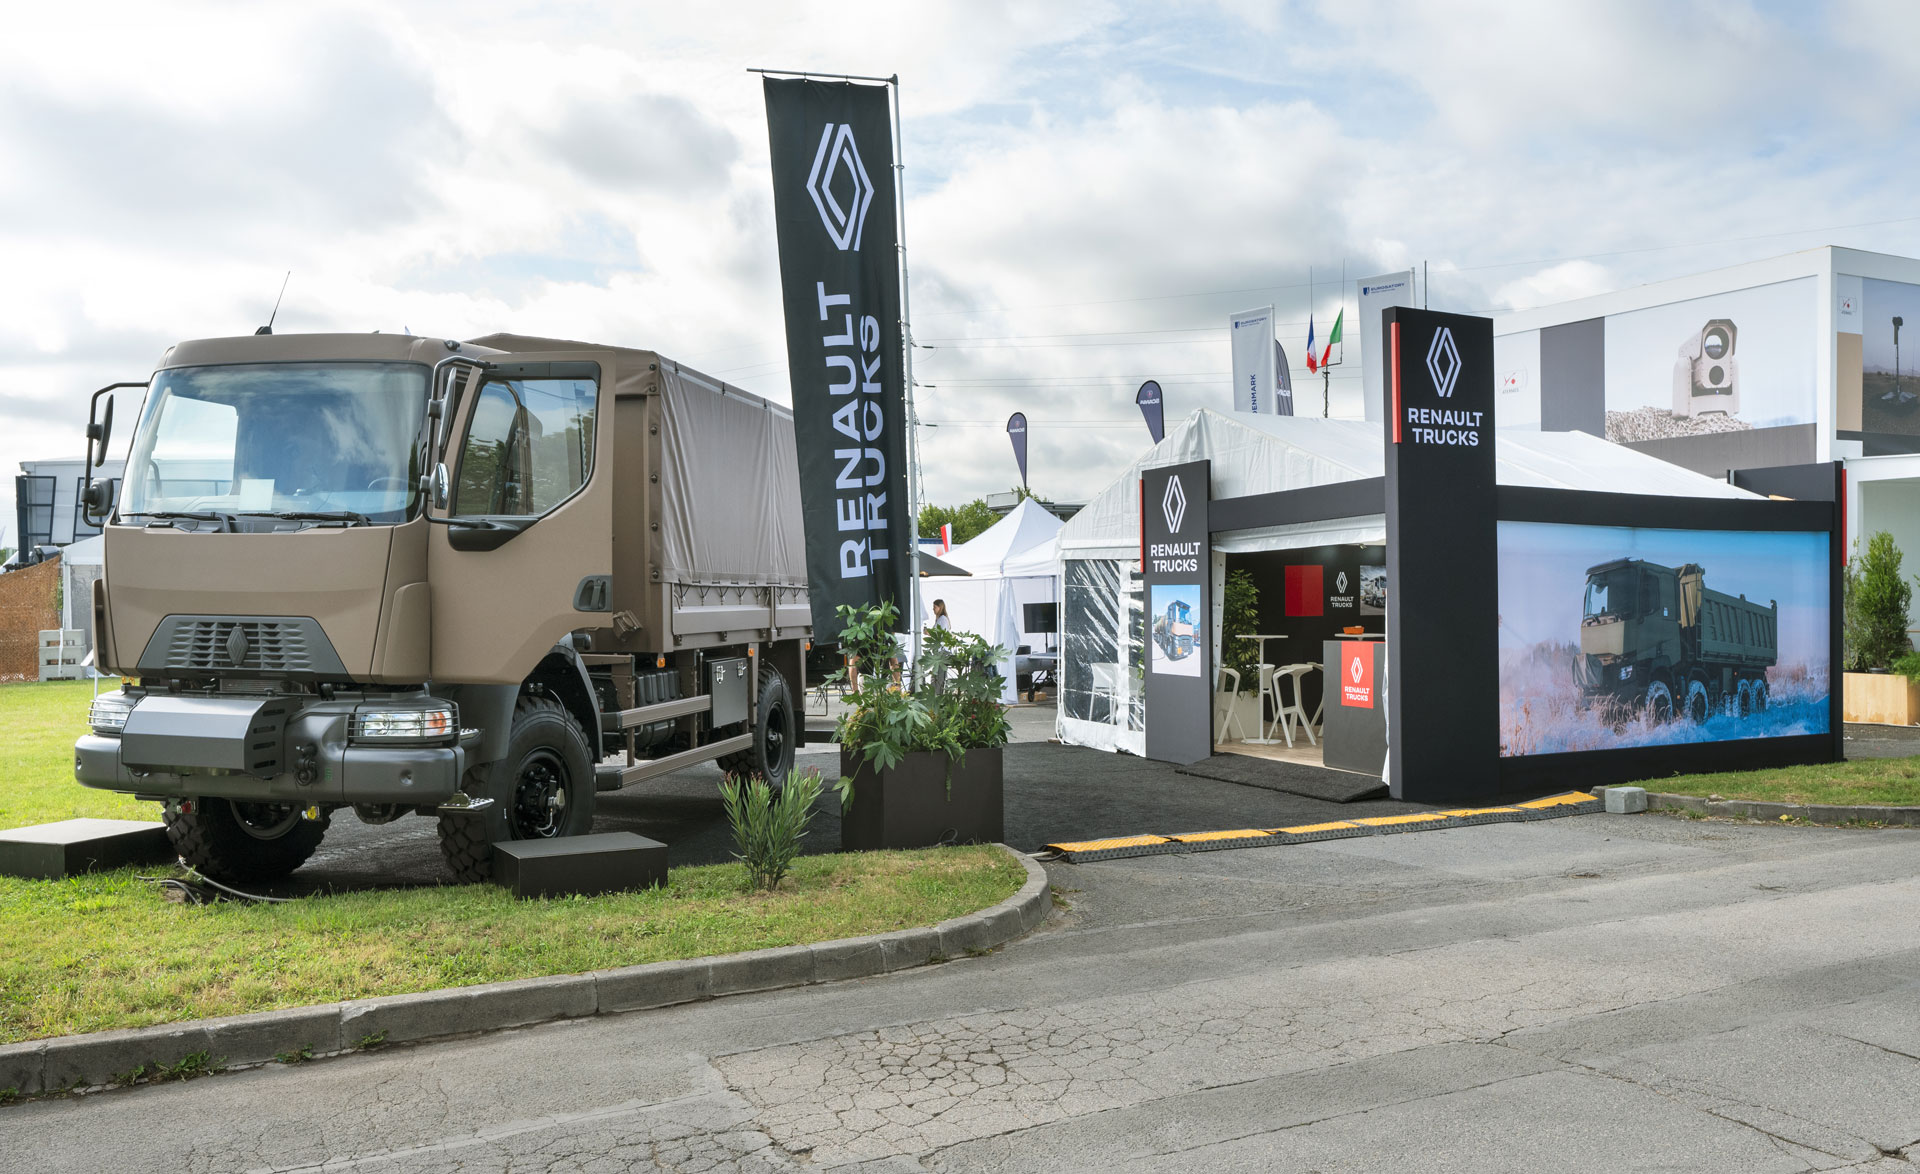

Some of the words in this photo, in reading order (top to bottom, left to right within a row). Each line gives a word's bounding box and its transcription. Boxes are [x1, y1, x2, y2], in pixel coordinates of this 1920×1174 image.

[1408, 407, 1483, 427] RENAULT
[817, 281, 868, 578] RENAULT
[1412, 427, 1479, 446] TRUCKS
[860, 314, 889, 575] TRUCKS
[1150, 542, 1201, 557] RENAULT
[1153, 559, 1198, 573] TRUCKS
[1344, 686, 1370, 694] RENAULT
[1346, 693, 1369, 702] TRUCKS
